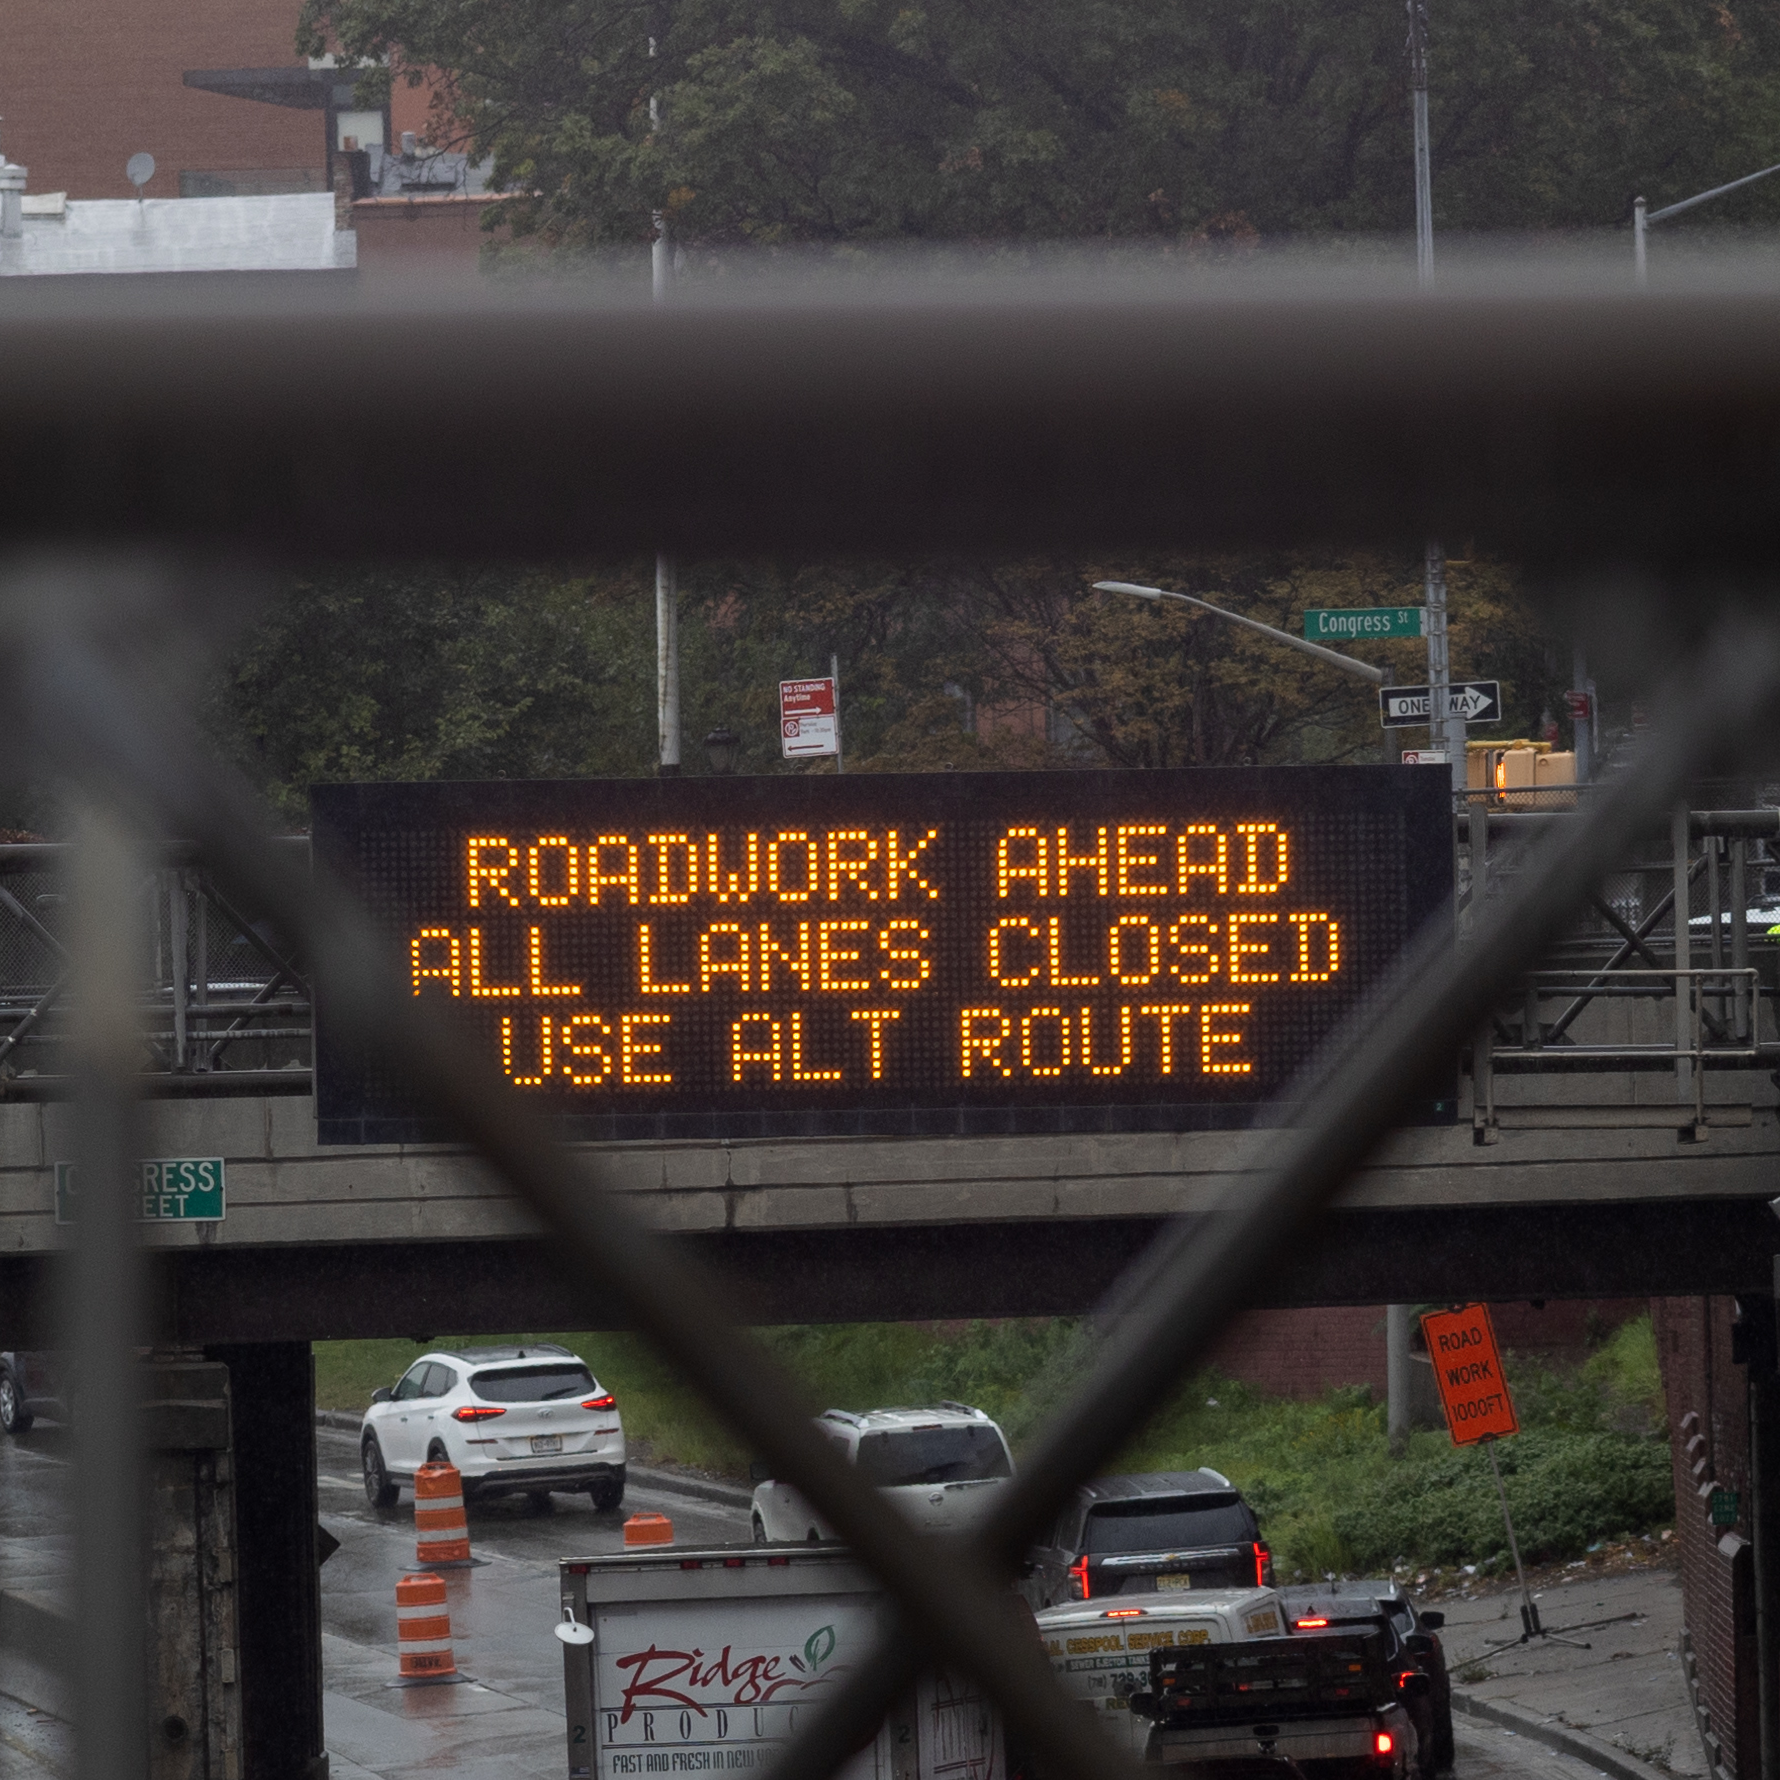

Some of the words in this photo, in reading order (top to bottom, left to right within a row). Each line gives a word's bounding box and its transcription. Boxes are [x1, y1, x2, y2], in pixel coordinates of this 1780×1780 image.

[1318, 612, 1391, 638] Congress
[1398, 610, 1409, 625] St
[784, 693, 811, 704] Anytime
[793, 683, 826, 693] STANDING
[1398, 698, 1430, 714] ONE
[1449, 695, 1481, 711] WAY
[466, 829, 939, 906] ROADWORK
[995, 823, 1290, 898] AHEAD
[410, 926, 581, 997] ALL
[637, 919, 930, 994] LANES
[987, 912, 1341, 987] CLOSED
[499, 1013, 672, 1087] USE
[730, 1009, 900, 1080] ALT
[960, 1003, 1252, 1078] ROUTE
[1438, 1327, 1483, 1352] ROAD
[1446, 1360, 1493, 1387] WORK
[1067, 1635, 1124, 1655] CESSPOOL
[1127, 1631, 1174, 1650] SERVICE
[1070, 1657, 1095, 1671] SEWER
[616, 1644, 786, 1725] Ridge
[572, 1725, 586, 1744] 2
[897, 1724, 910, 1744] 2
[613, 1753, 646, 1774] FAST
[647, 1753, 670, 1772] AND
[672, 1751, 711, 1772] FRESH
[713, 1751, 726, 1770] IN
[727, 1749, 755, 1769] NEW
